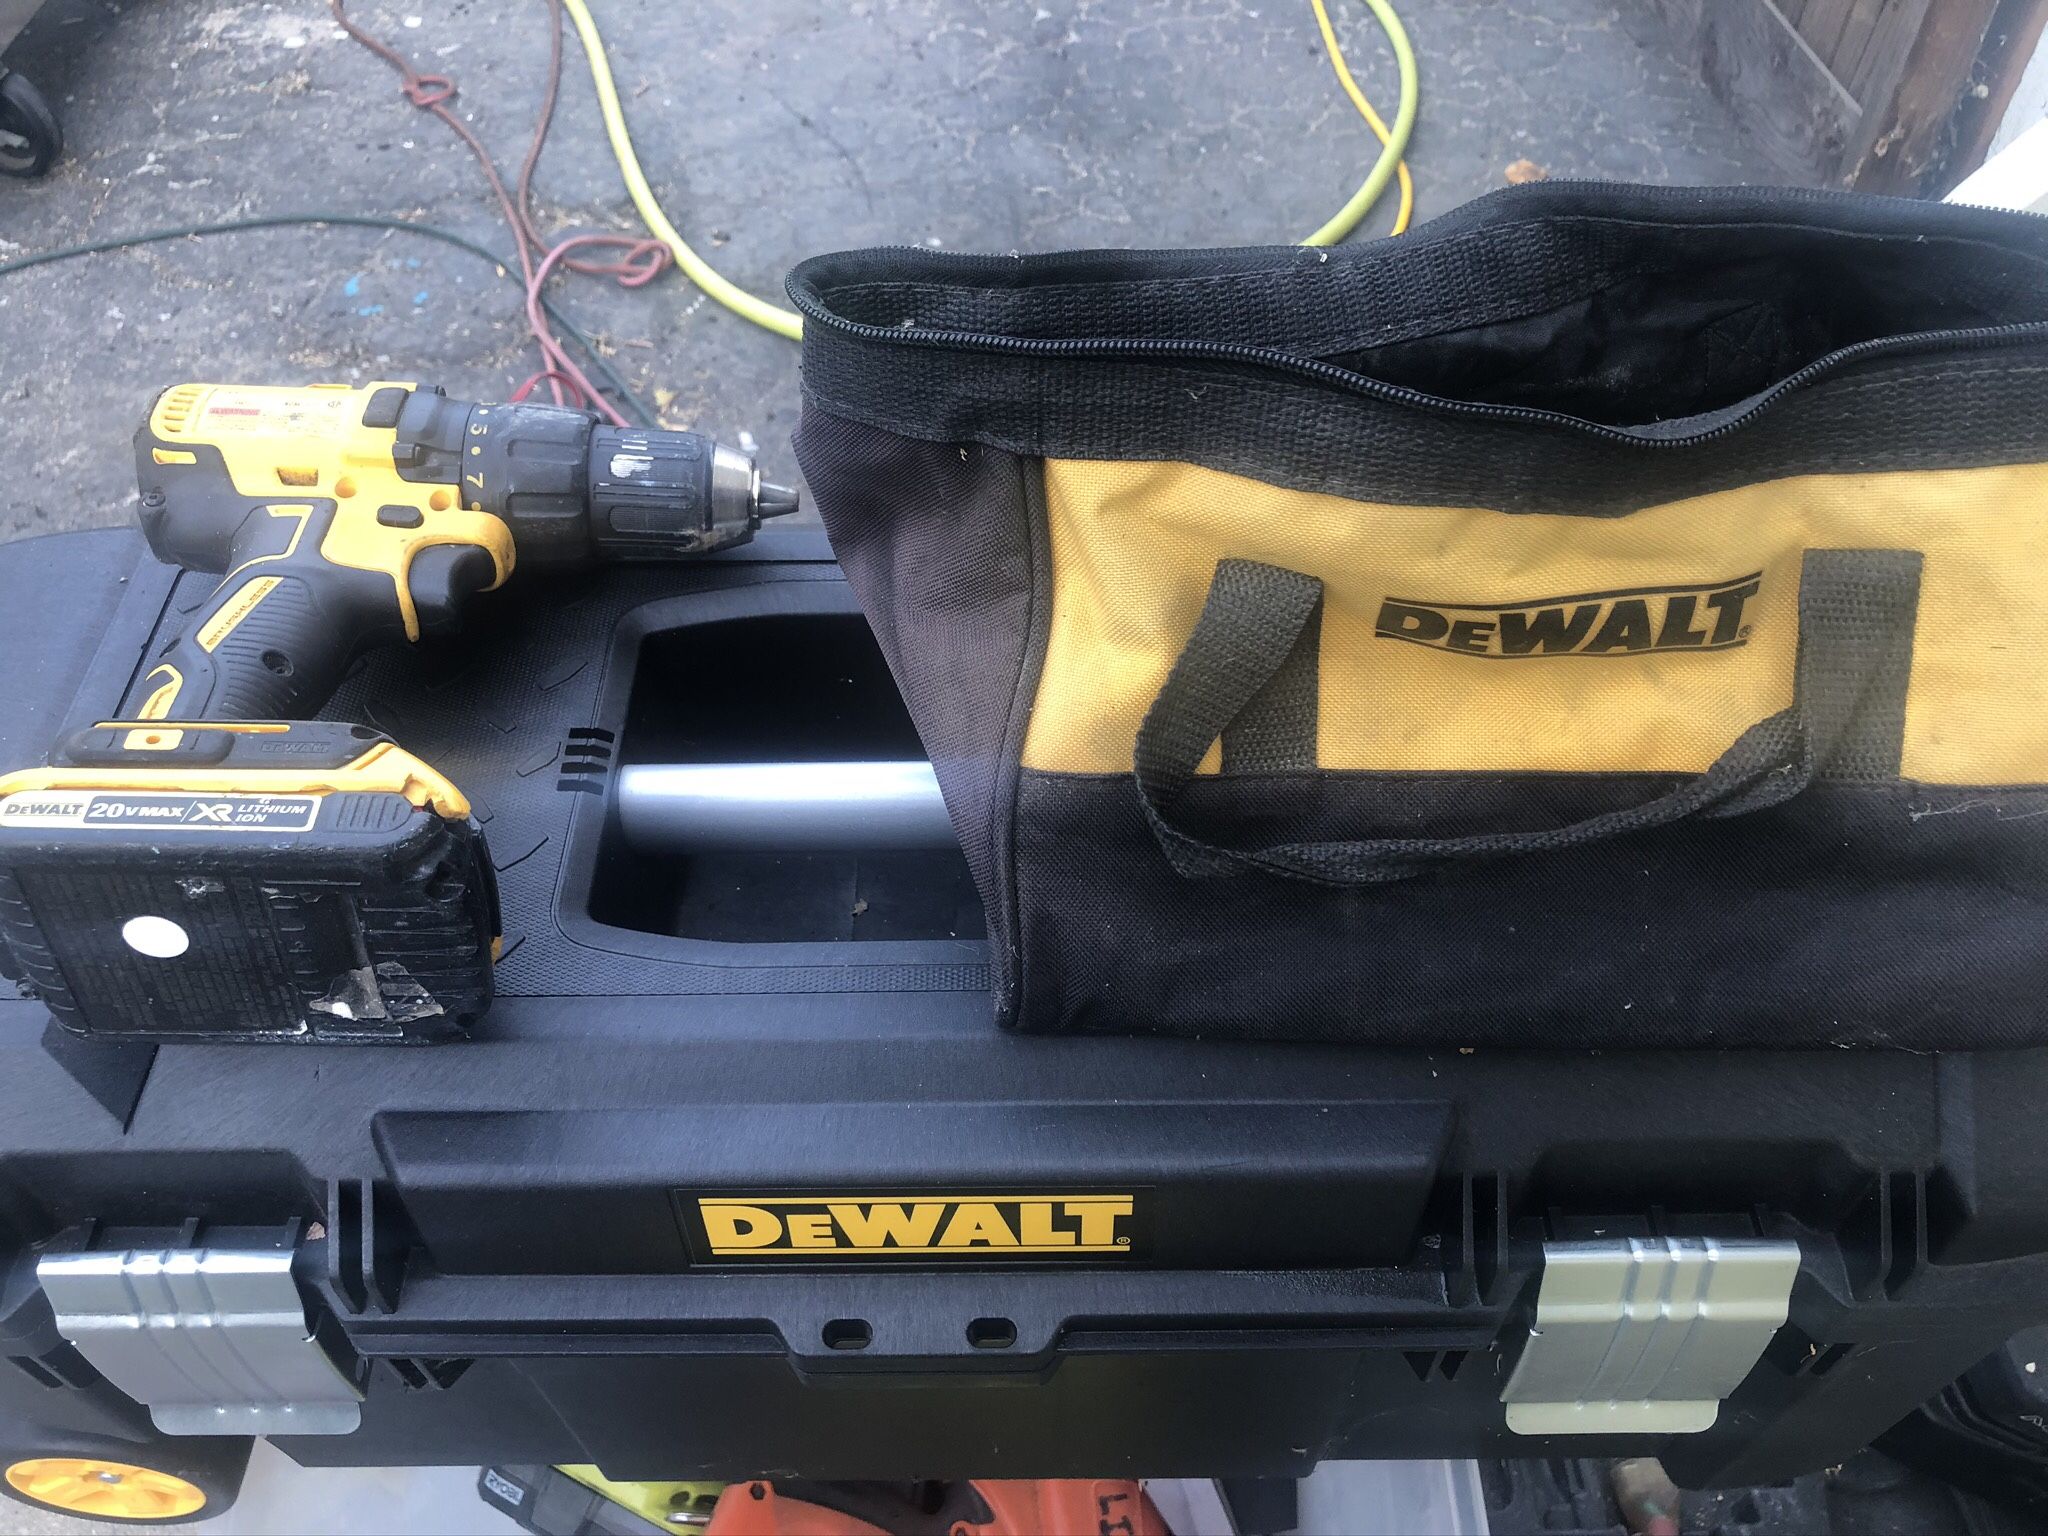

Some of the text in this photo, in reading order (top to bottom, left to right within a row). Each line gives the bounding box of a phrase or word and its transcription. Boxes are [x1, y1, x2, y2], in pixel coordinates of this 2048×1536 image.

[466, 472, 484, 489] 7
[1376, 580, 1761, 654] DEWALT
[4, 803, 84, 815] DEWALT
[238, 804, 308, 814] LITHIUM
[235, 813, 268, 823] ION
[700, 1202, 1134, 1249] DEWALT
